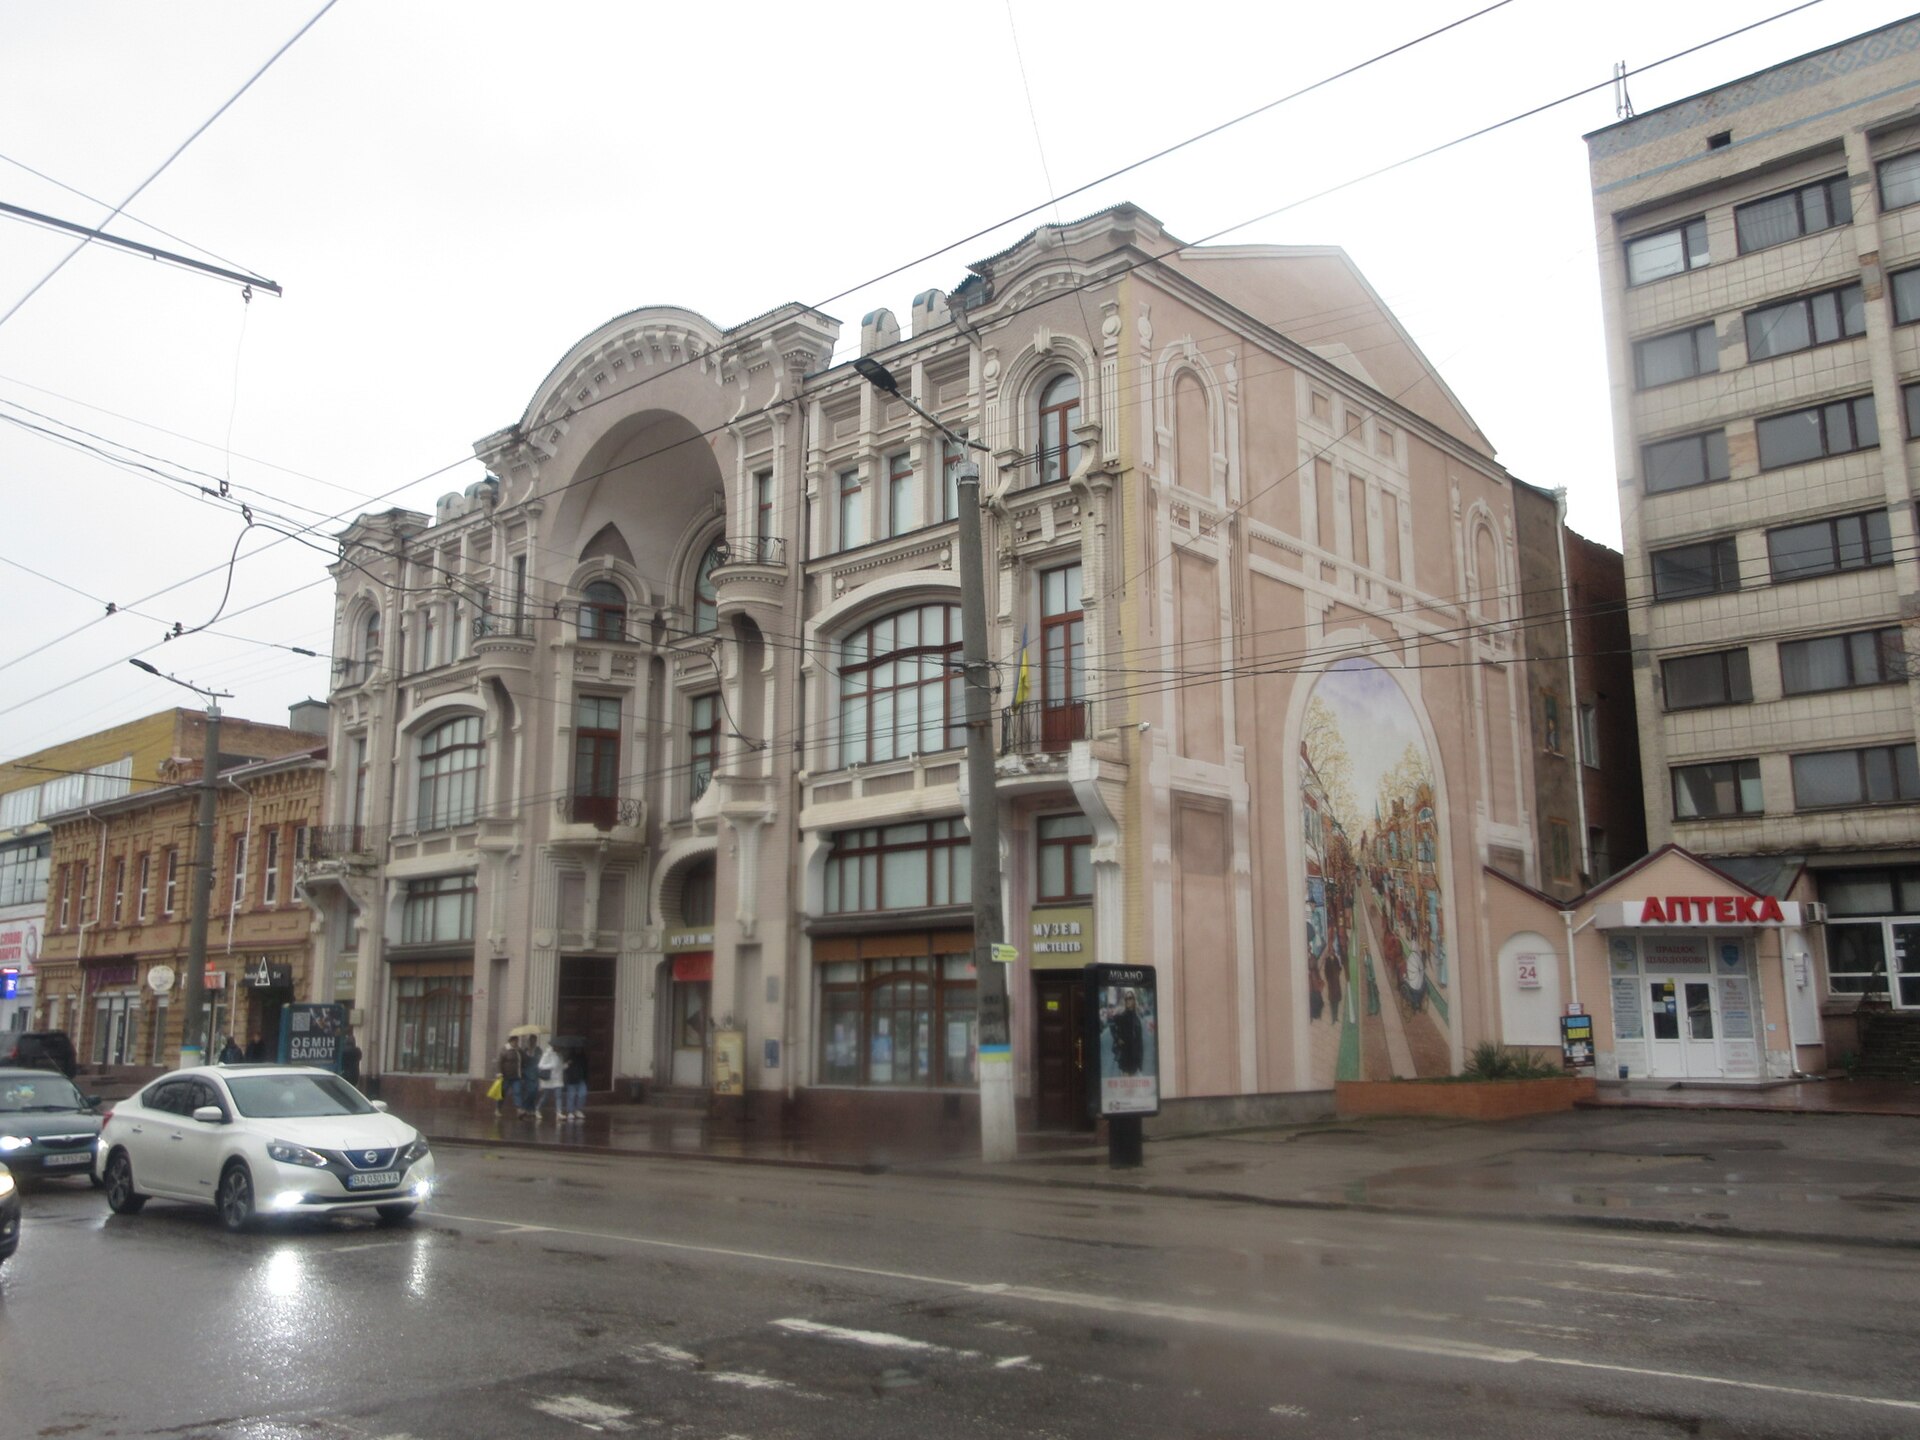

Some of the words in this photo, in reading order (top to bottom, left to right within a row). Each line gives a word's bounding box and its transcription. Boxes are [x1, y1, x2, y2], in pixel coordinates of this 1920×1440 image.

[1640, 896, 1785, 923] АПТЕКА
[1033, 921, 1081, 938] МУЗЕЙ
[1109, 970, 1143, 980] MILANO
[1519, 966, 1537, 979] 24
[291, 1037, 335, 1048] ОБМІН
[291, 1048, 335, 1059] ВАЛЮТ
